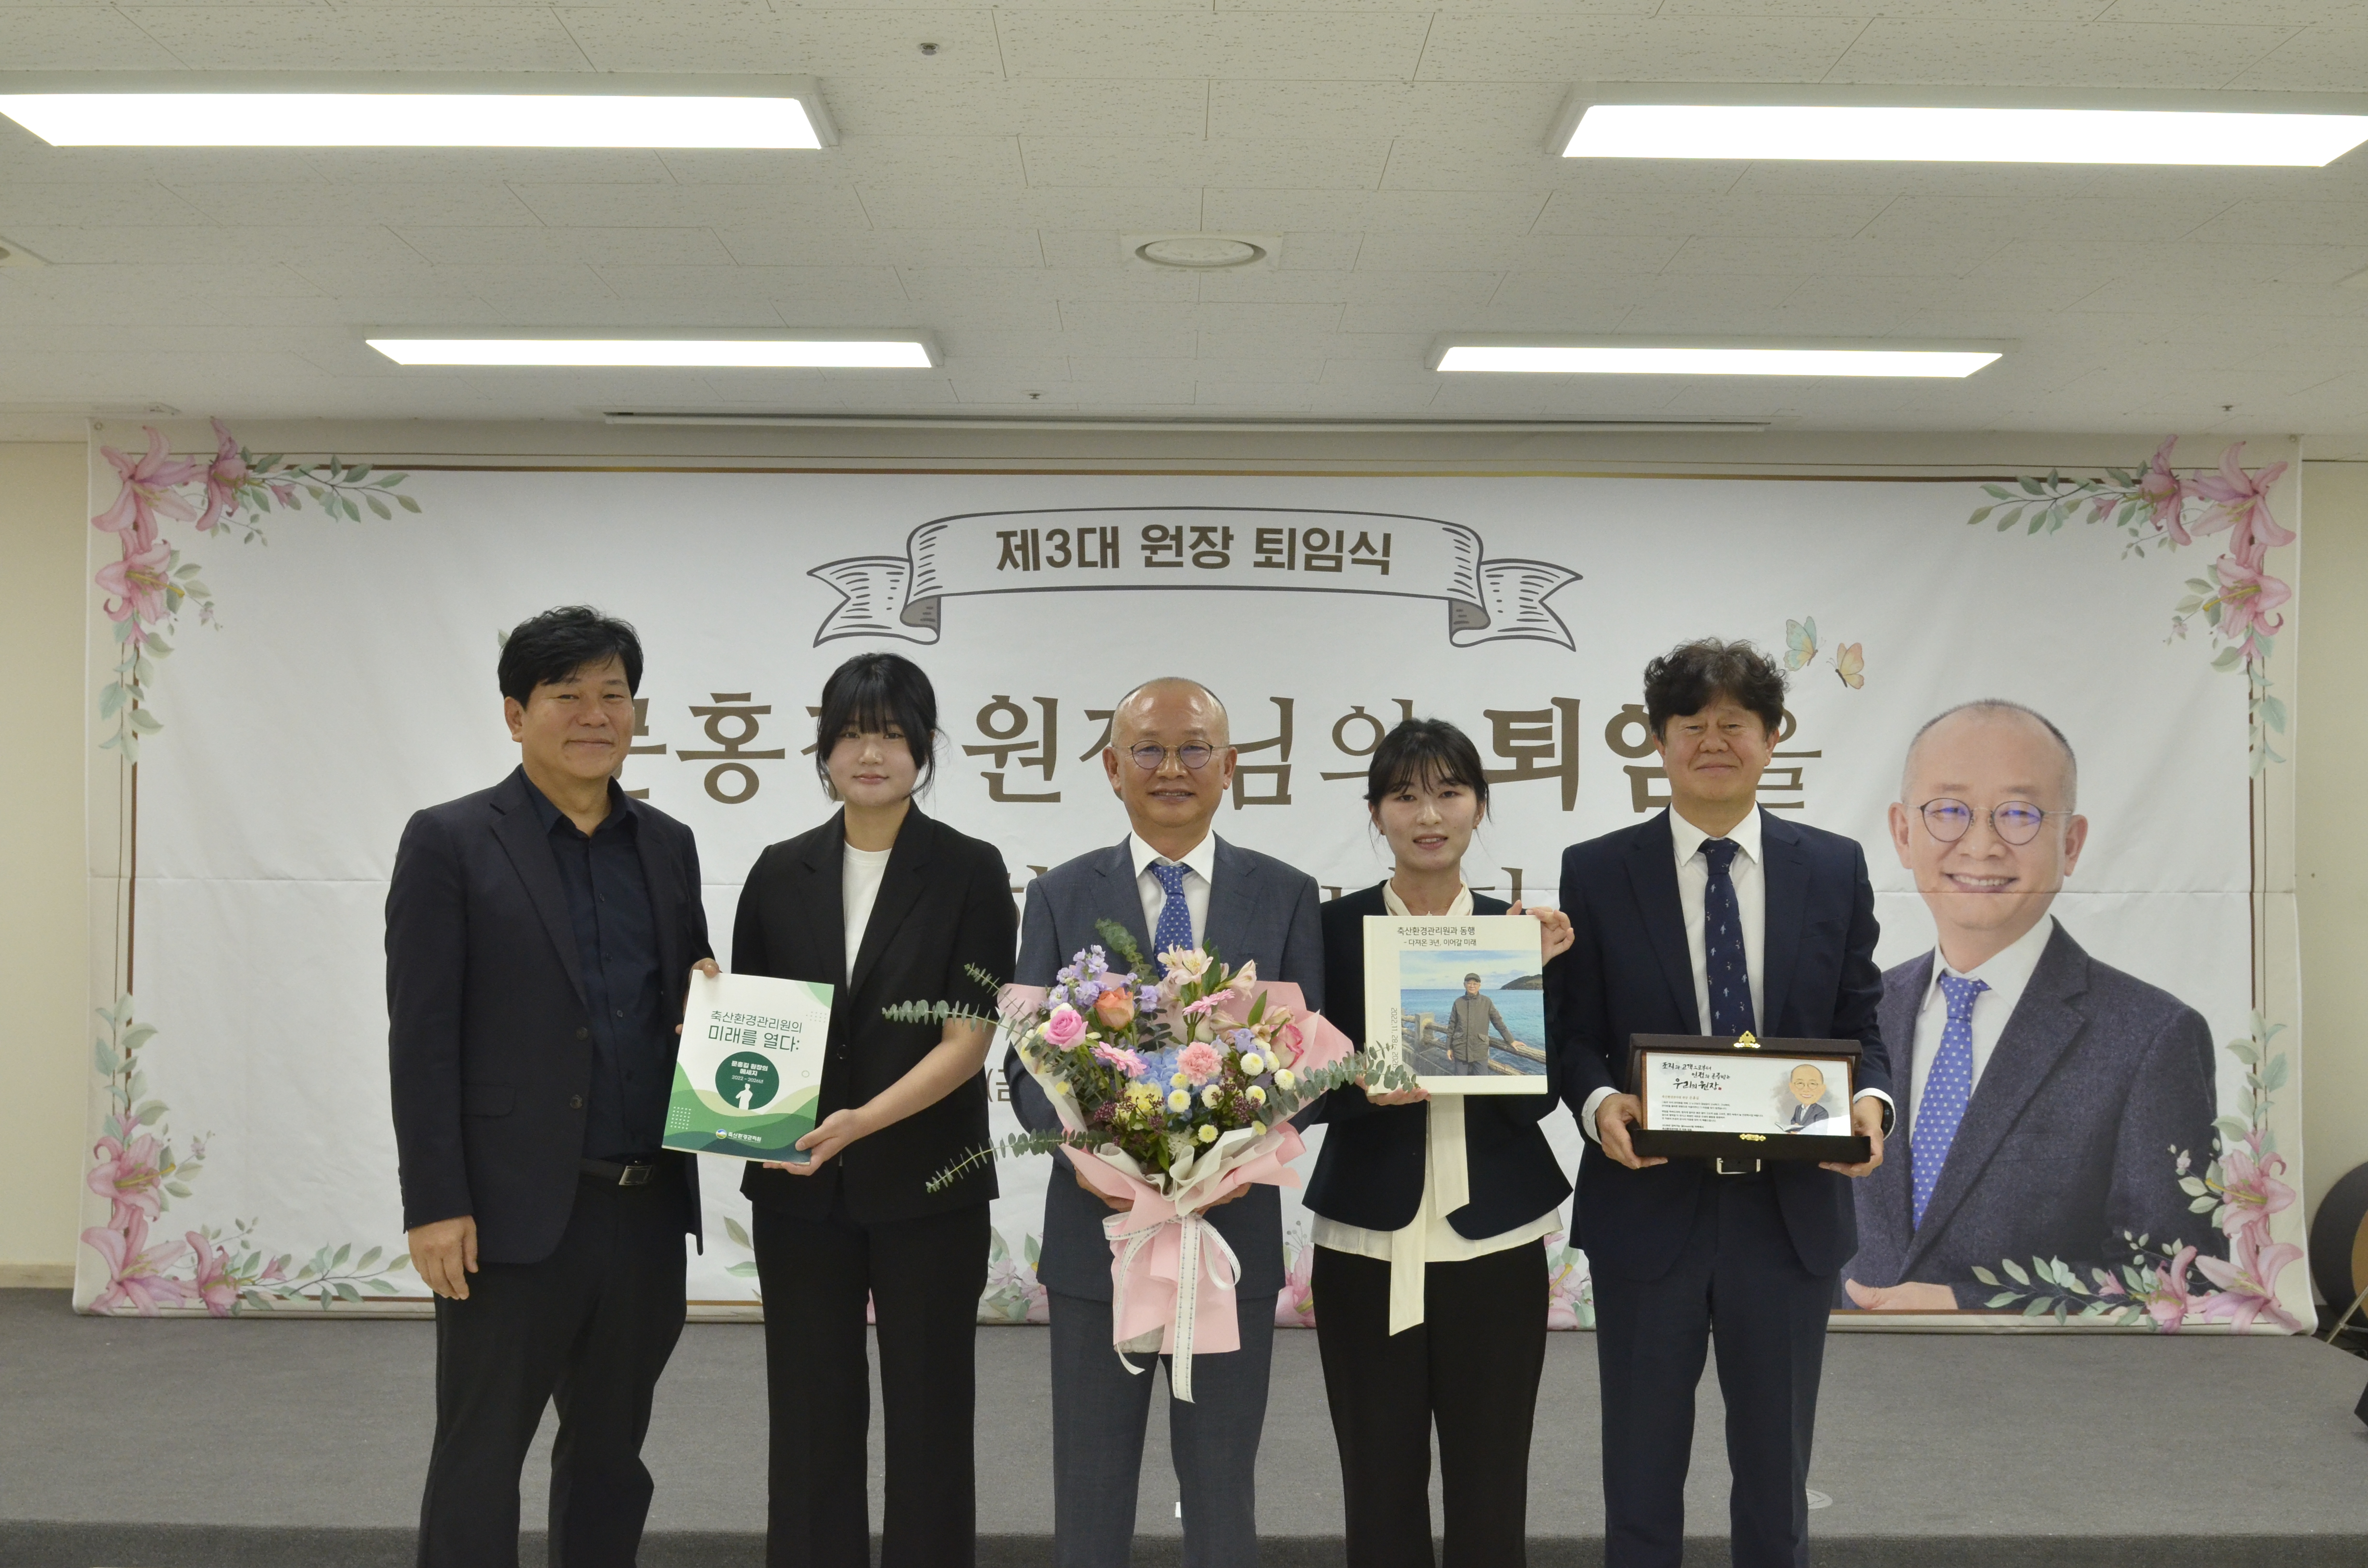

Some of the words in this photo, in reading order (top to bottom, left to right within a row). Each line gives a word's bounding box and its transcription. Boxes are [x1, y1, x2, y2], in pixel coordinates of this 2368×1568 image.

[996, 526, 1120, 571] 제3대
[1141, 524, 1234, 569] 원장
[1253, 527, 1392, 576] 퇴임식
[1397, 927, 1457, 935] 축산환경관리원과
[1460, 926, 1475, 935] 동행
[711, 1010, 802, 1033] 축산환경관리원의
[708, 1025, 757, 1046] 미래를
[764, 1032, 800, 1052] 열다:
[751, 1063, 768, 1072] 원장의
[1673, 1078, 1697, 1089] 우리의
[1698, 1080, 1719, 1090] 원장
